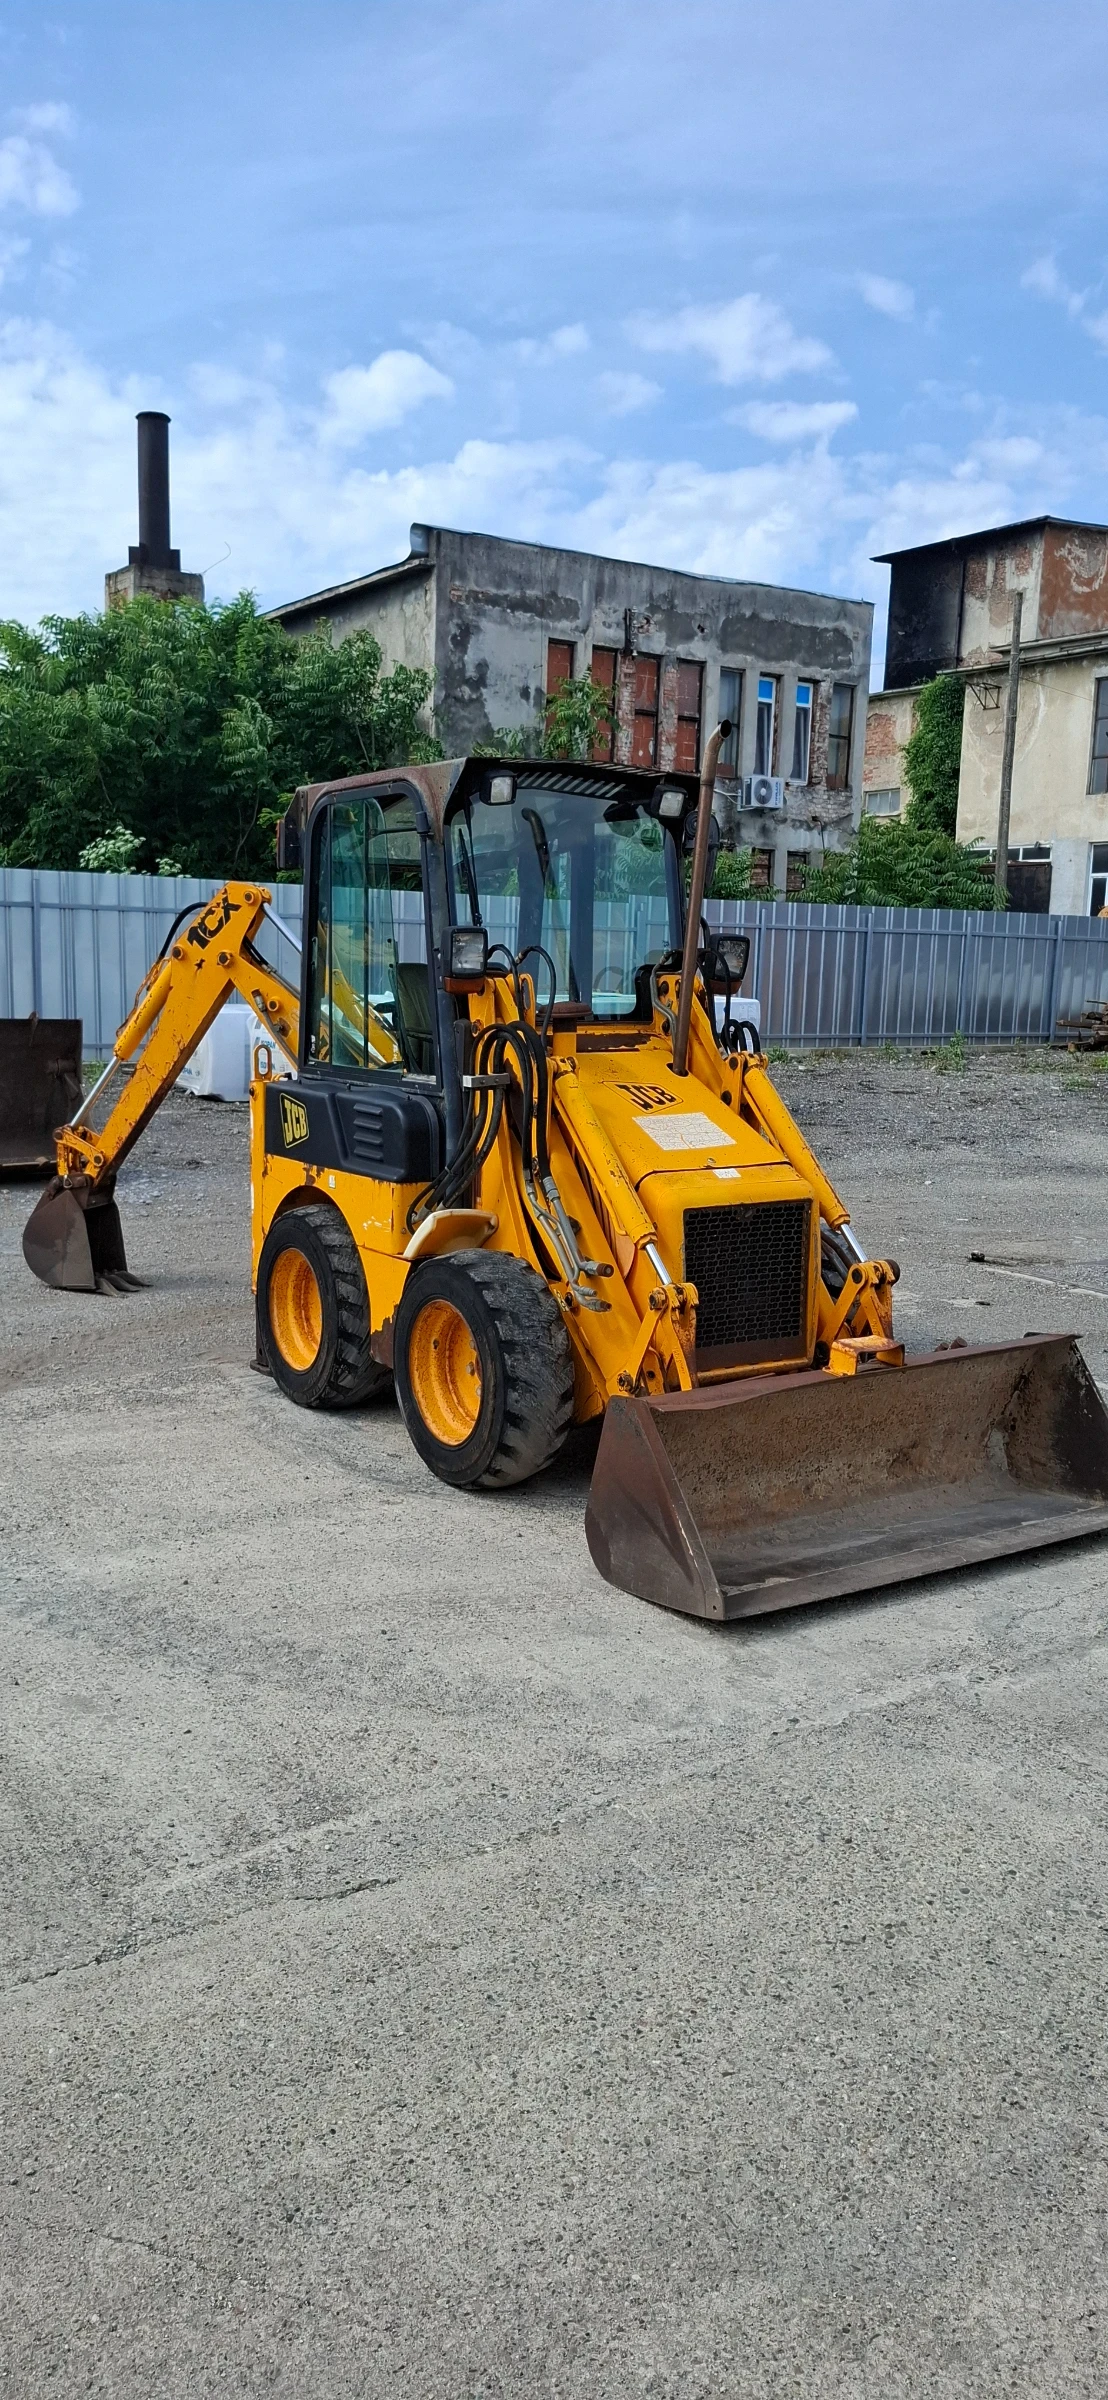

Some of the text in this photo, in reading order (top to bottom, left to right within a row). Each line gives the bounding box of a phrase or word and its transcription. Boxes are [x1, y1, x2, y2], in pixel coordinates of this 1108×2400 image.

[187, 887, 242, 950] 1CX
[614, 1083, 678, 1111] JCB
[284, 1098, 308, 1144] JCB
